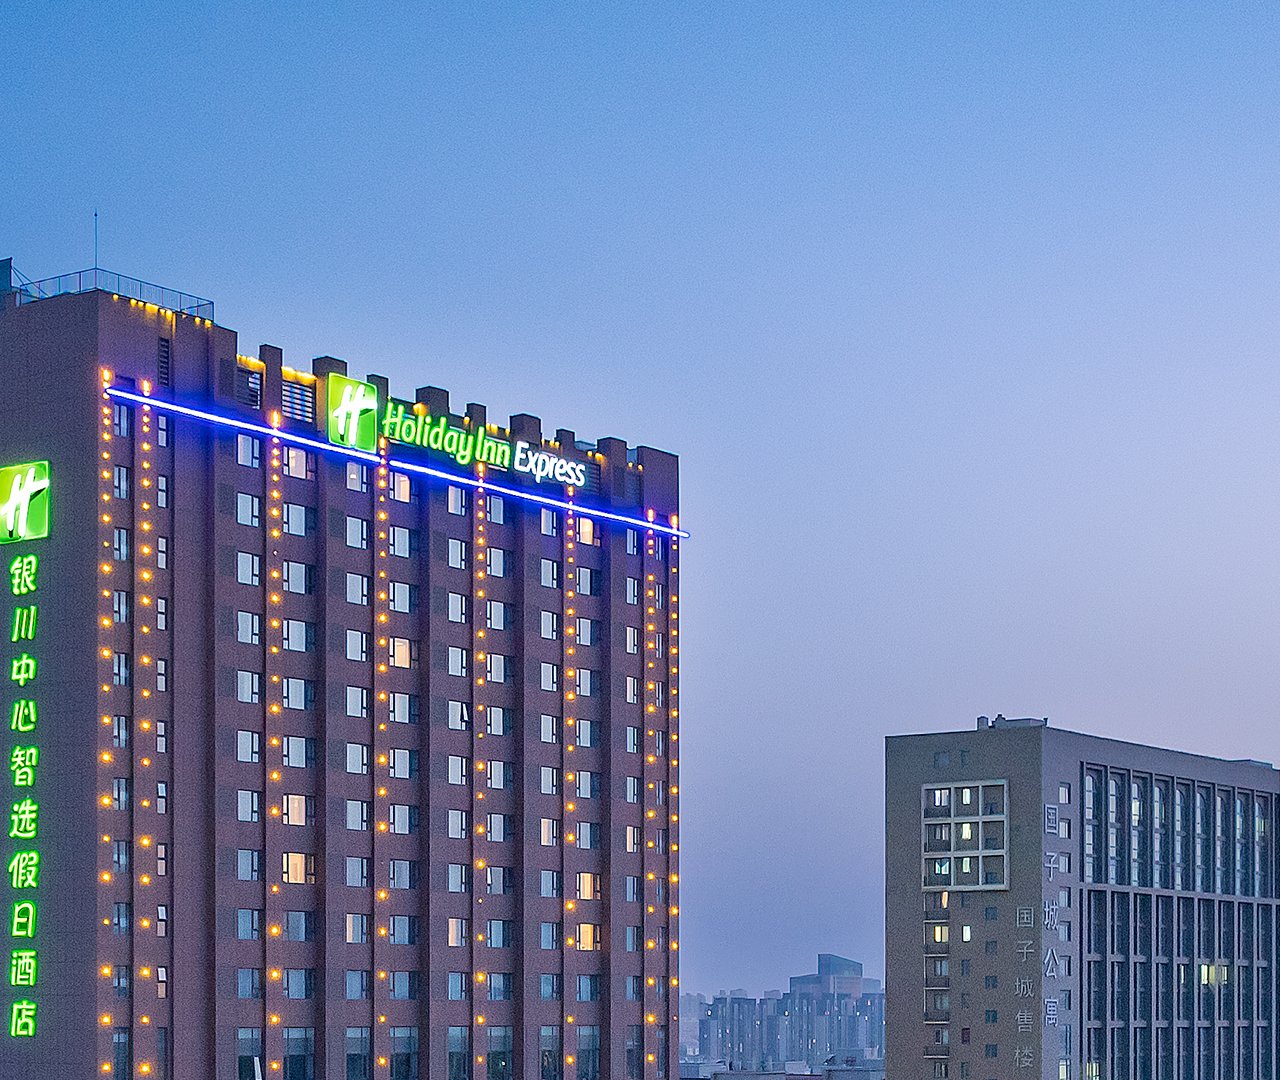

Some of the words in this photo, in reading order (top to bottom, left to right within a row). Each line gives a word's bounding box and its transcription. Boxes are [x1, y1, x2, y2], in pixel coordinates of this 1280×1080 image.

[381, 401, 474, 466] Holiday
[475, 426, 511, 468] Inn
[514, 440, 586, 487] Express
[8, 553, 38, 1038] 银川中心智选假日酒店
[1043, 803, 1060, 1028] 国子城公寓
